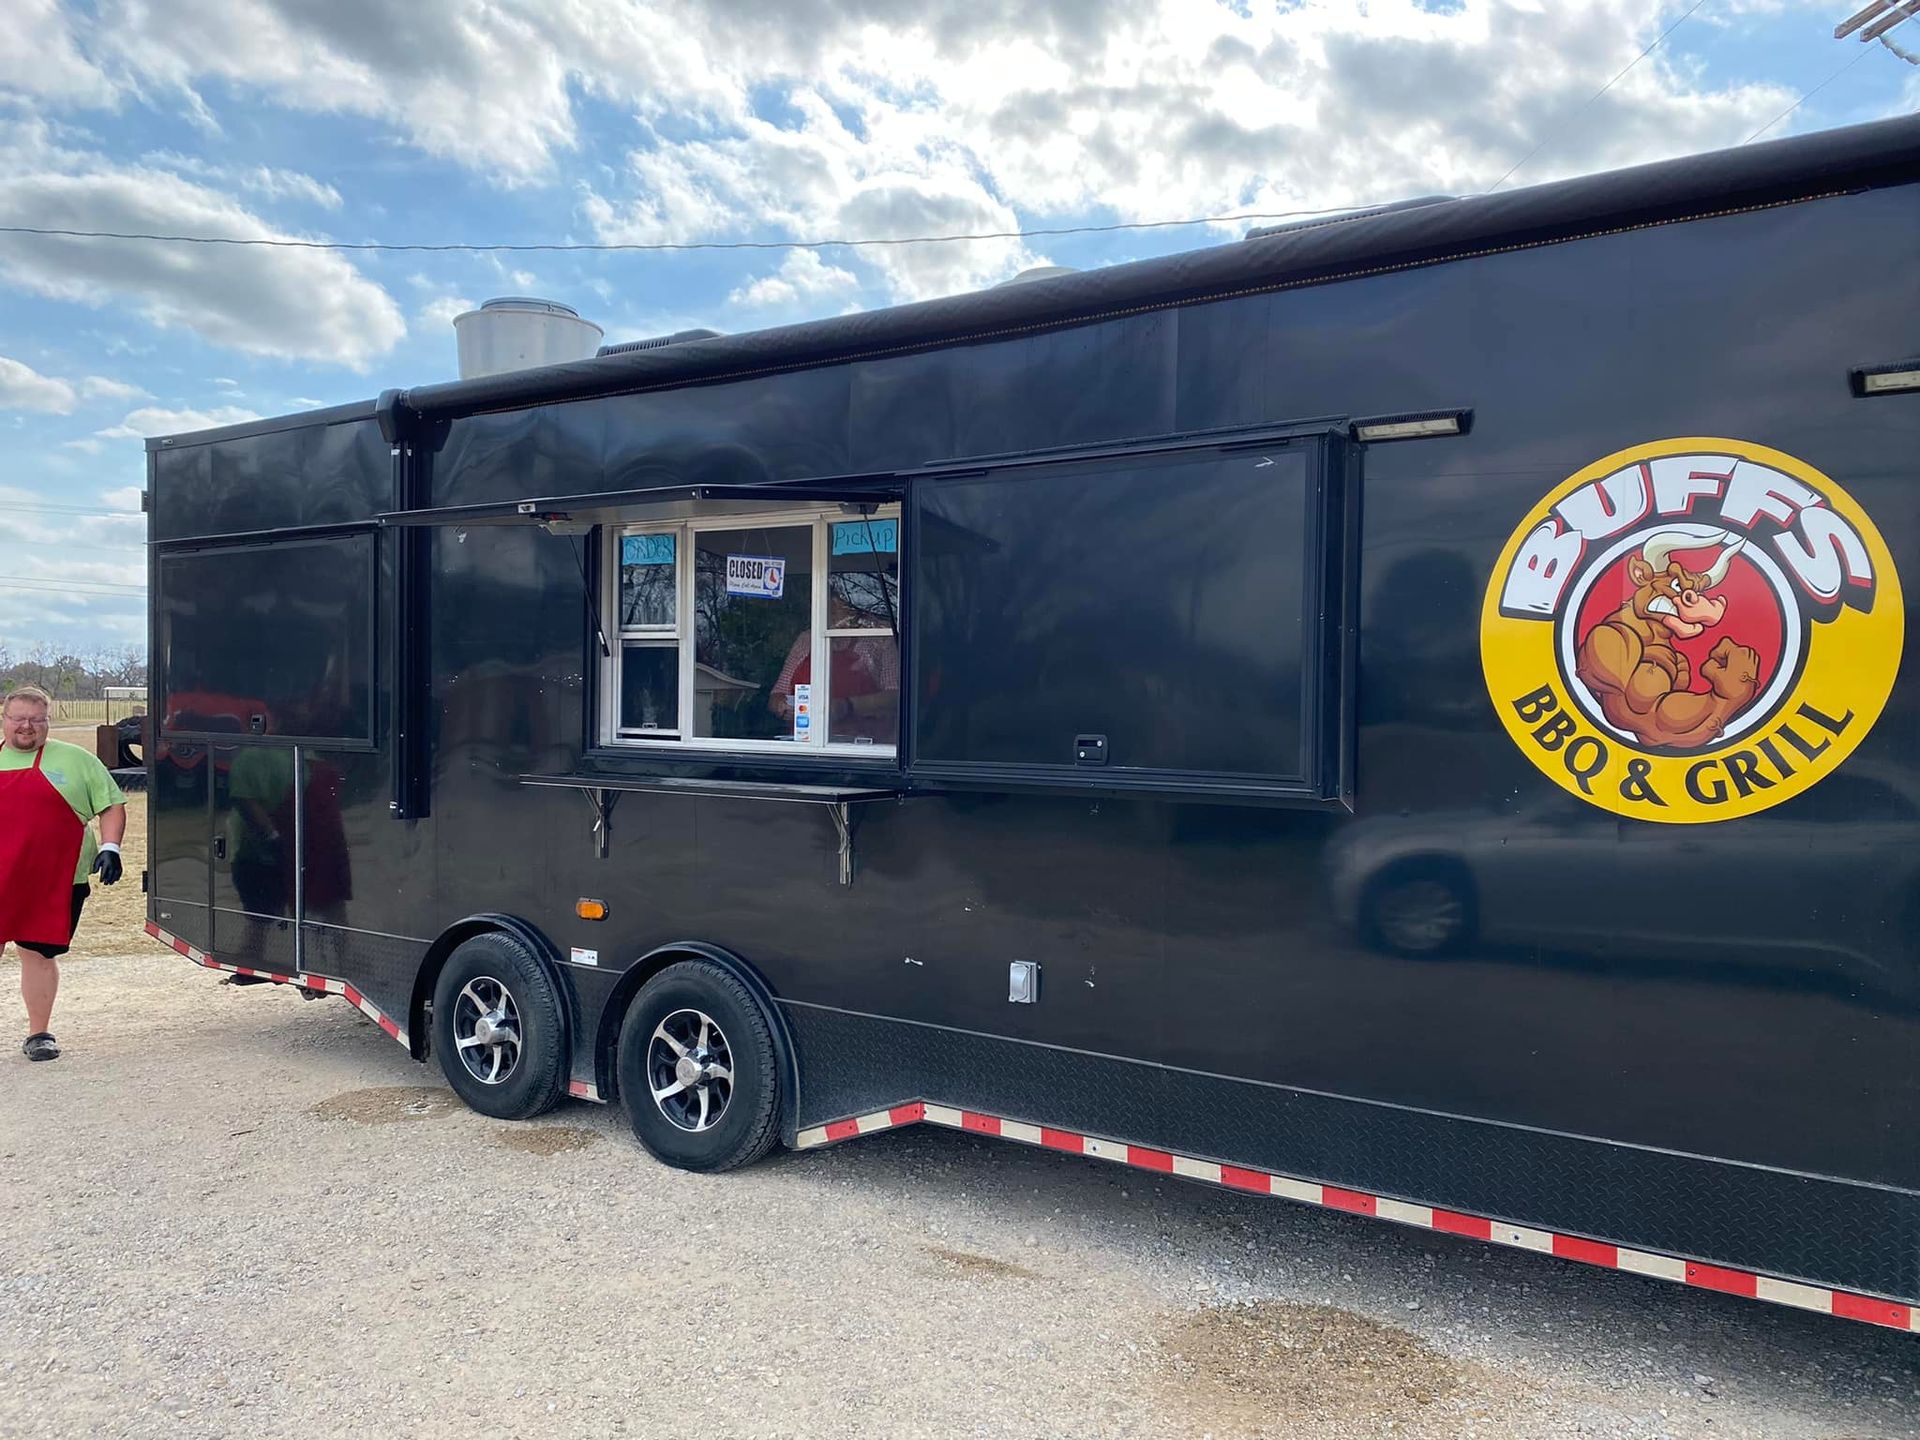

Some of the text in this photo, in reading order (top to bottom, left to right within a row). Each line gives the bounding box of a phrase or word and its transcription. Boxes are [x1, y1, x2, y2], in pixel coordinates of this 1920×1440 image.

[729, 559, 763, 580] CLOSED
[1502, 454, 1873, 616] BUFFS
[1511, 682, 1855, 807] BBQ & GRILL
